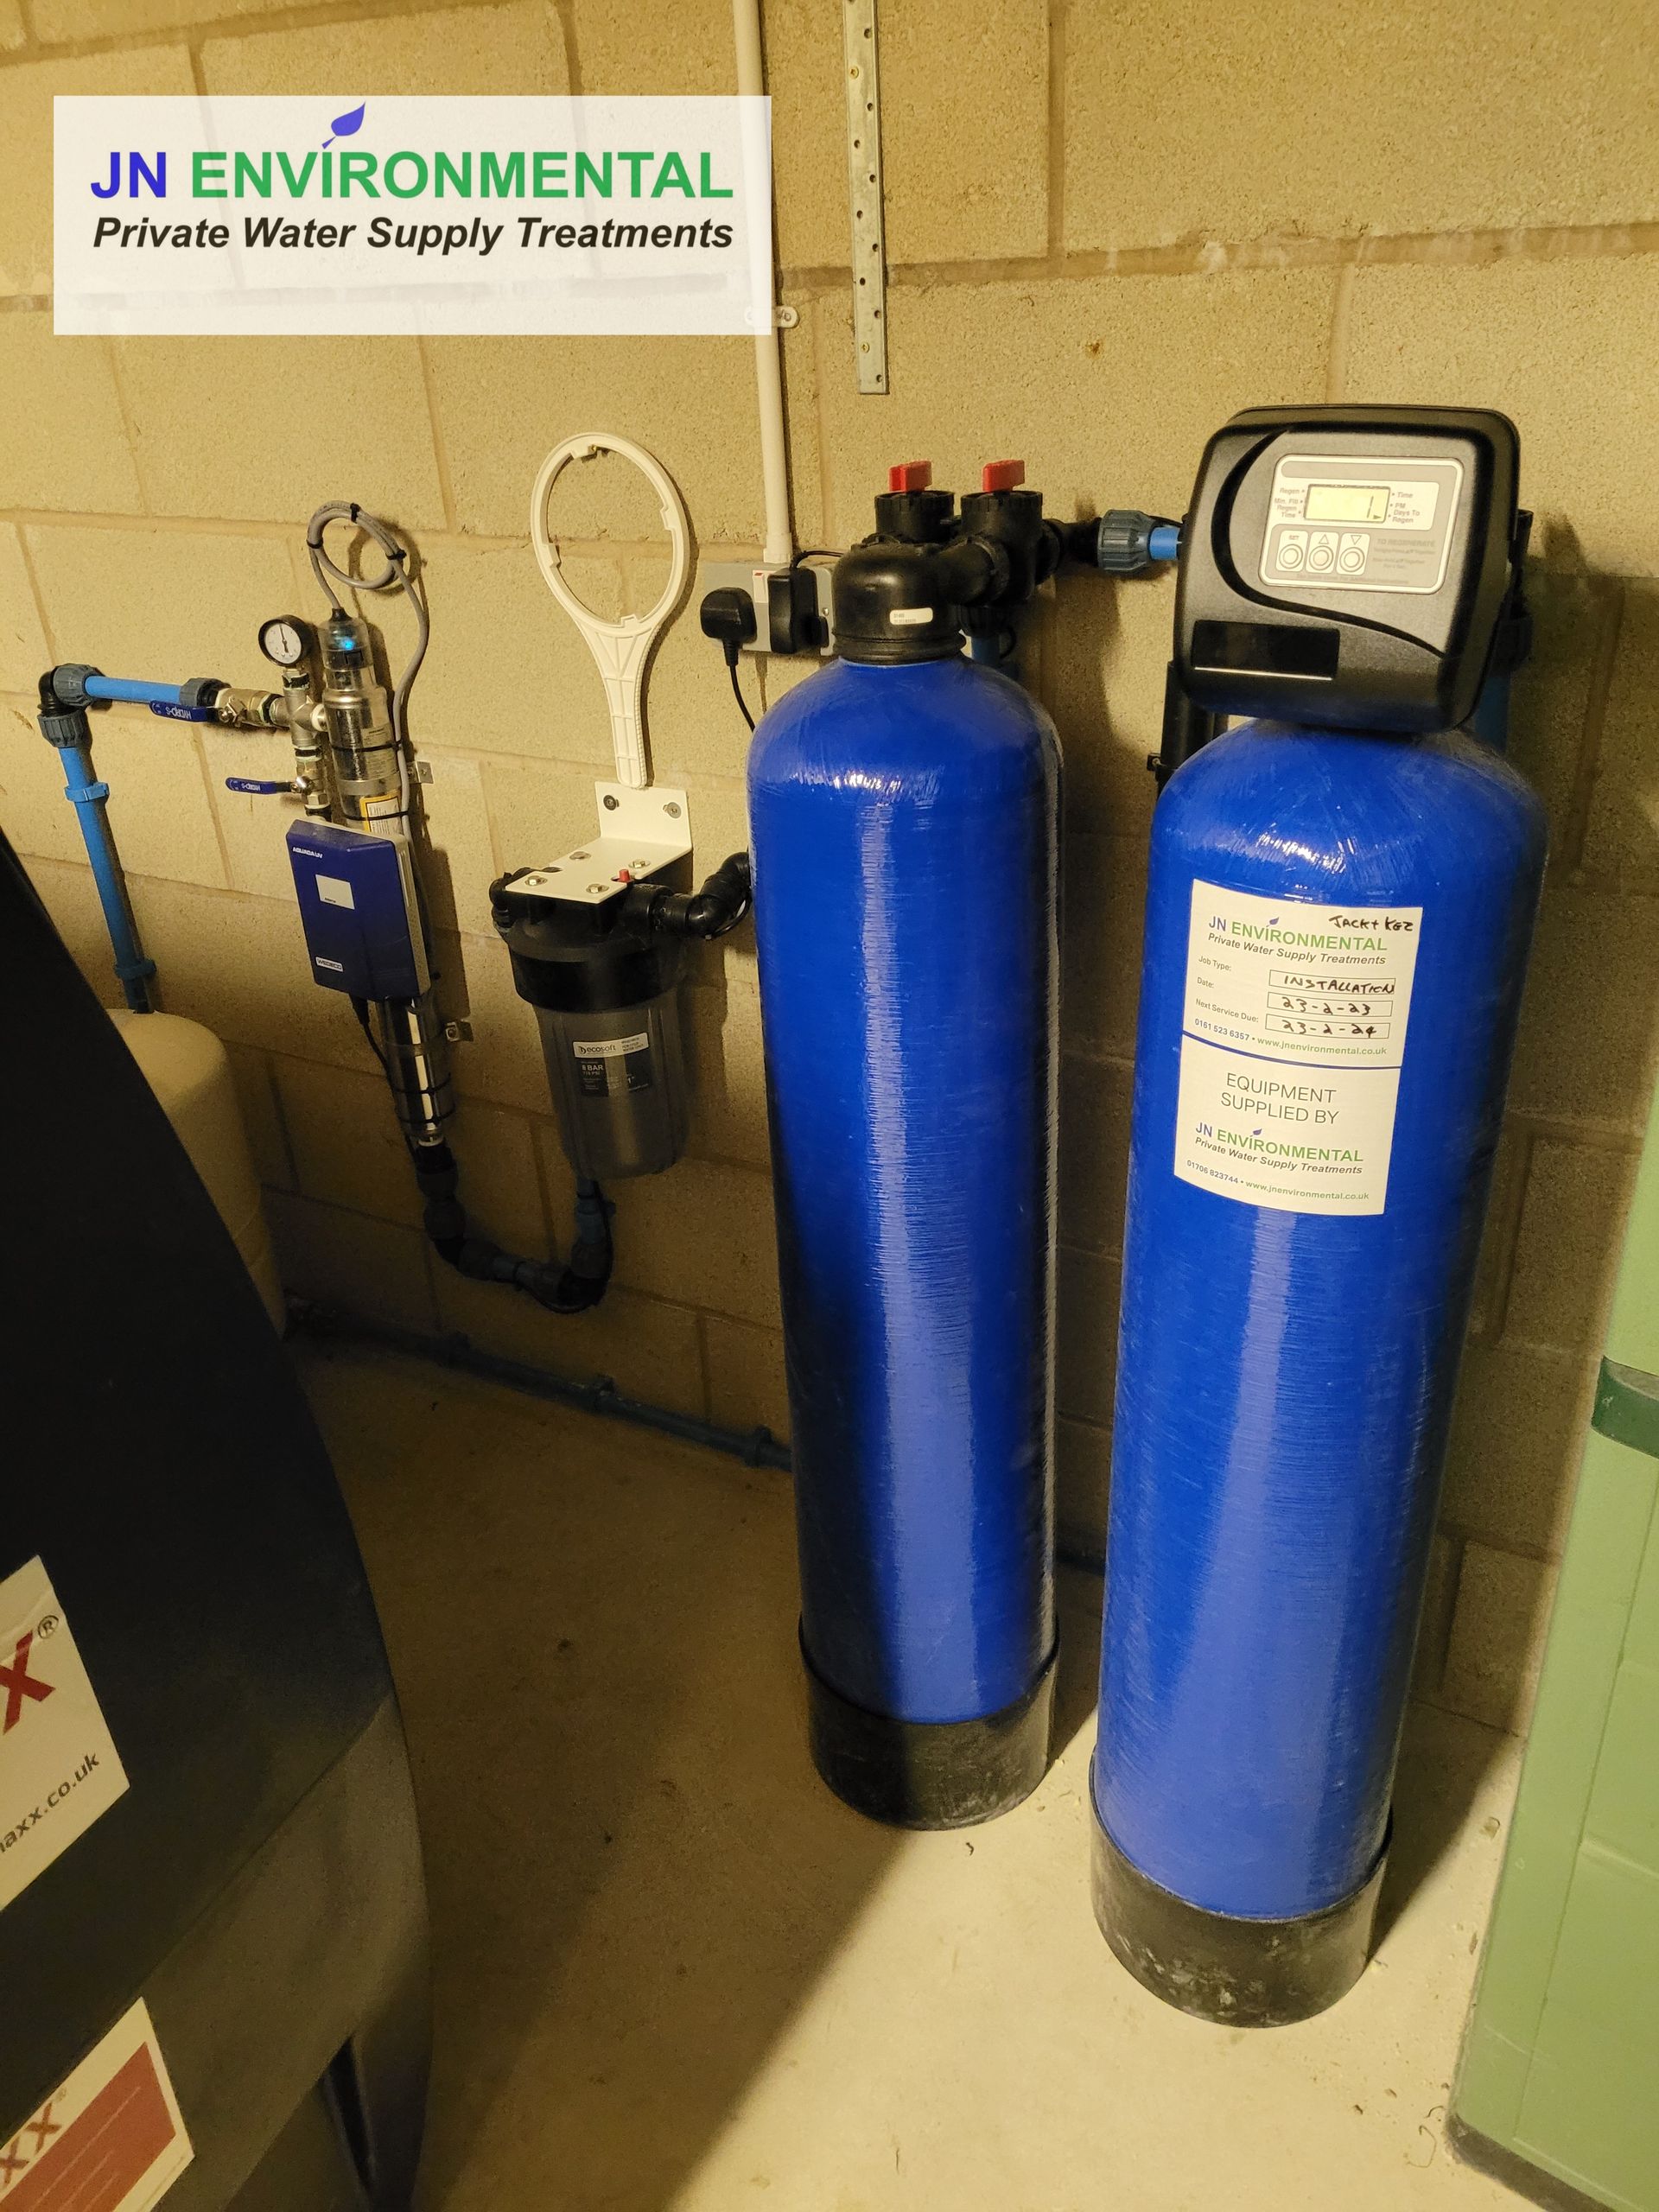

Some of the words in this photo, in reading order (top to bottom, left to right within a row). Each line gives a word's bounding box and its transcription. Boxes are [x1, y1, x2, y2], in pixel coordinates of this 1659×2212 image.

[1208, 932, 1241, 949] Private
[1243, 941, 1274, 956] Water
[1276, 948, 1317, 963] Supply
[1320, 953, 1386, 964] Treatments
[1209, 916, 1226, 931] JN
[1231, 921, 1388, 950] ENVIRONMENTAL
[1198, 956, 1211, 965] Job
[1212, 960, 1231, 971] Type:
[1197, 976, 1214, 988] Date:
[1196, 998, 1211, 1010] Next
[1211, 1004, 1239, 1018] Service
[1241, 1012, 1259, 1023] Due:
[587, 1044, 616, 1053] ecosoft
[1195, 1018, 1211, 1031] 0161
[1213, 1025, 1228, 1035] 523
[1230, 1030, 1250, 1041] 6357
[1257, 1037, 1388, 1055] www.jnenvironmental.co.uk
[1226, 1072, 1337, 1103] EQUIPMENT
[1221, 1092, 1309, 1122] SUPPLIED
[1314, 1109, 1339, 1124] BY
[1195, 1136, 1226, 1154] Private
[1229, 1148, 1258, 1162] Water
[1260, 1156, 1298, 1172] Supply
[1301, 1162, 1363, 1174] Treatments
[1196, 1122, 1212, 1137] JN
[1217, 1128, 1363, 1162] ENVIRONMENTAL
[1186, 1160, 1209, 1174] 01706
[1209, 1169, 1238, 1185] 823744
[1245, 1180, 1370, 1200] www.jnenvironmental.co.uk
